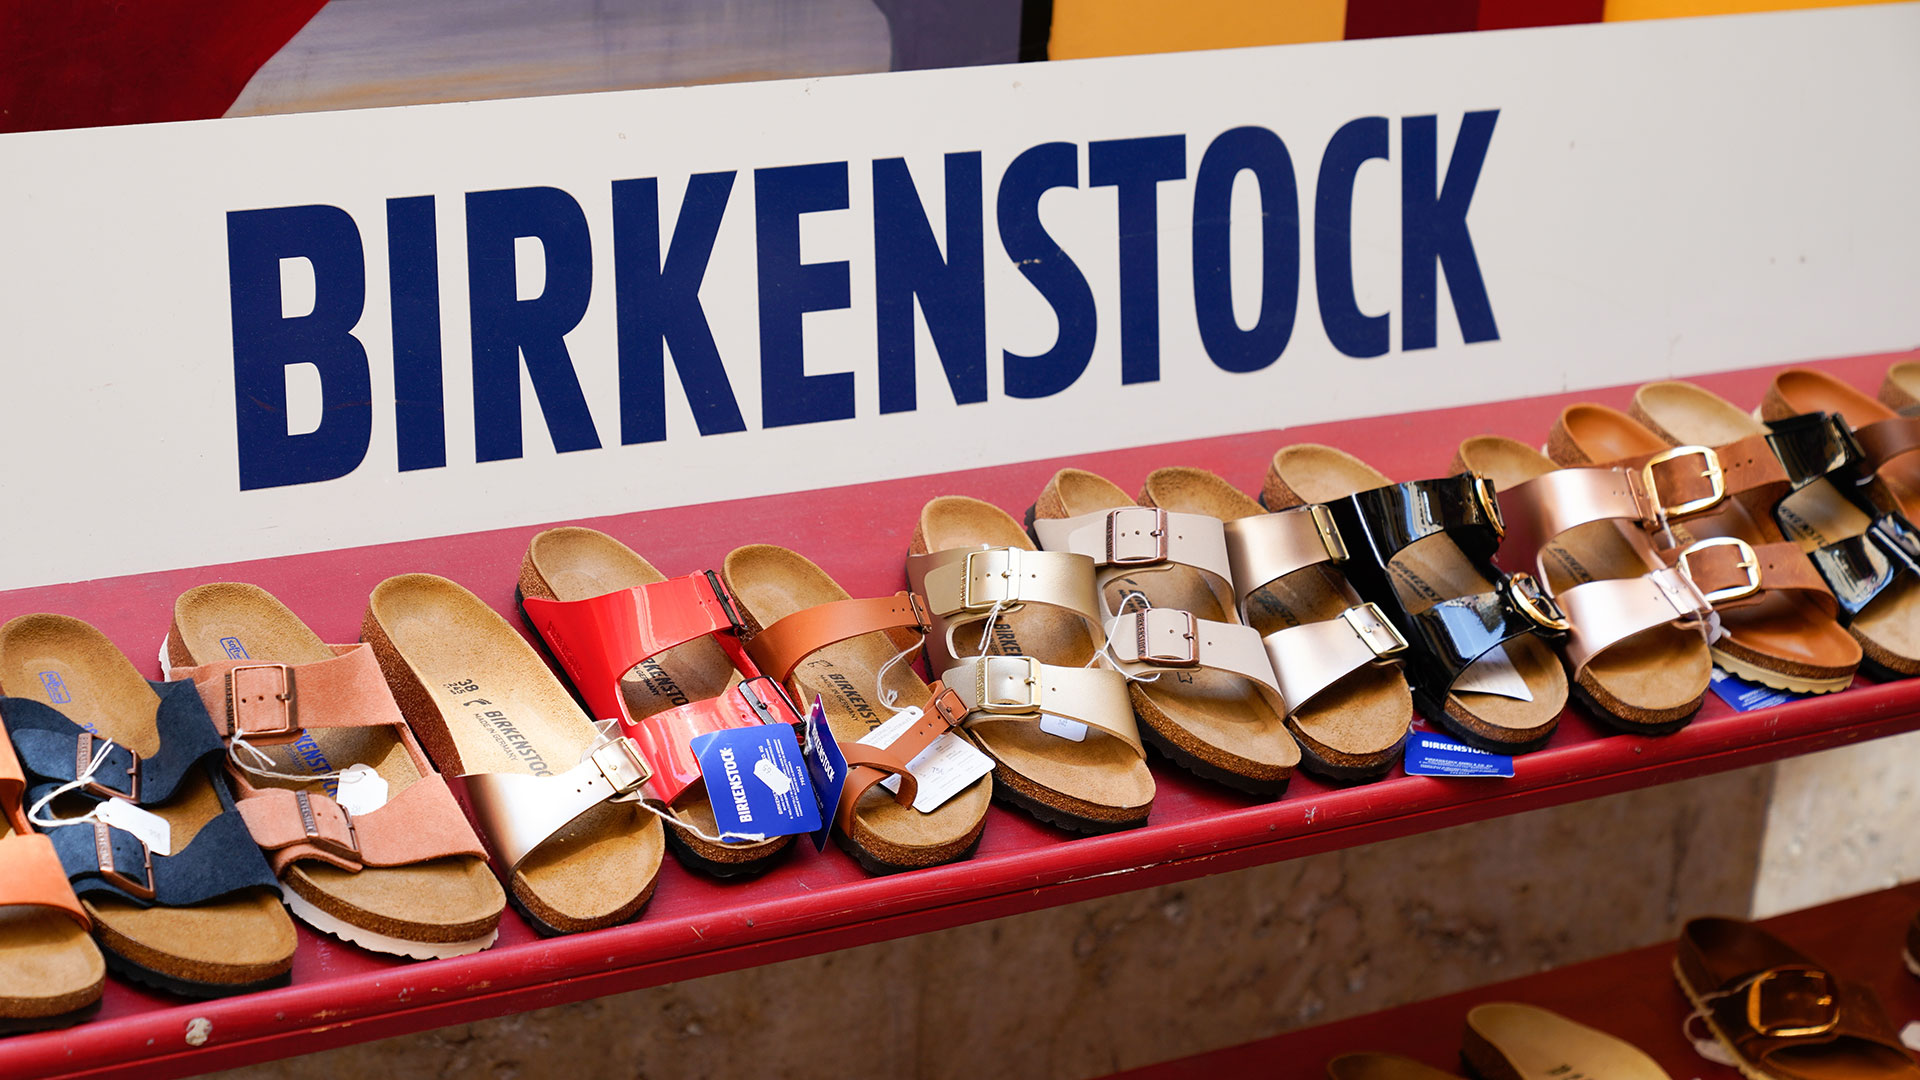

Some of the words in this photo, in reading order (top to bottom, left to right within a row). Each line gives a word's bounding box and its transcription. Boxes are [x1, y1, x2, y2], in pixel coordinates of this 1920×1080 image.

[226, 109, 1501, 492] BIRKENSTOCK
[458, 679, 479, 692] 38
[474, 713, 491, 728] MADE
[493, 731, 518, 761] GERMANY
[719, 747, 753, 823] BIRKENSTOCK
